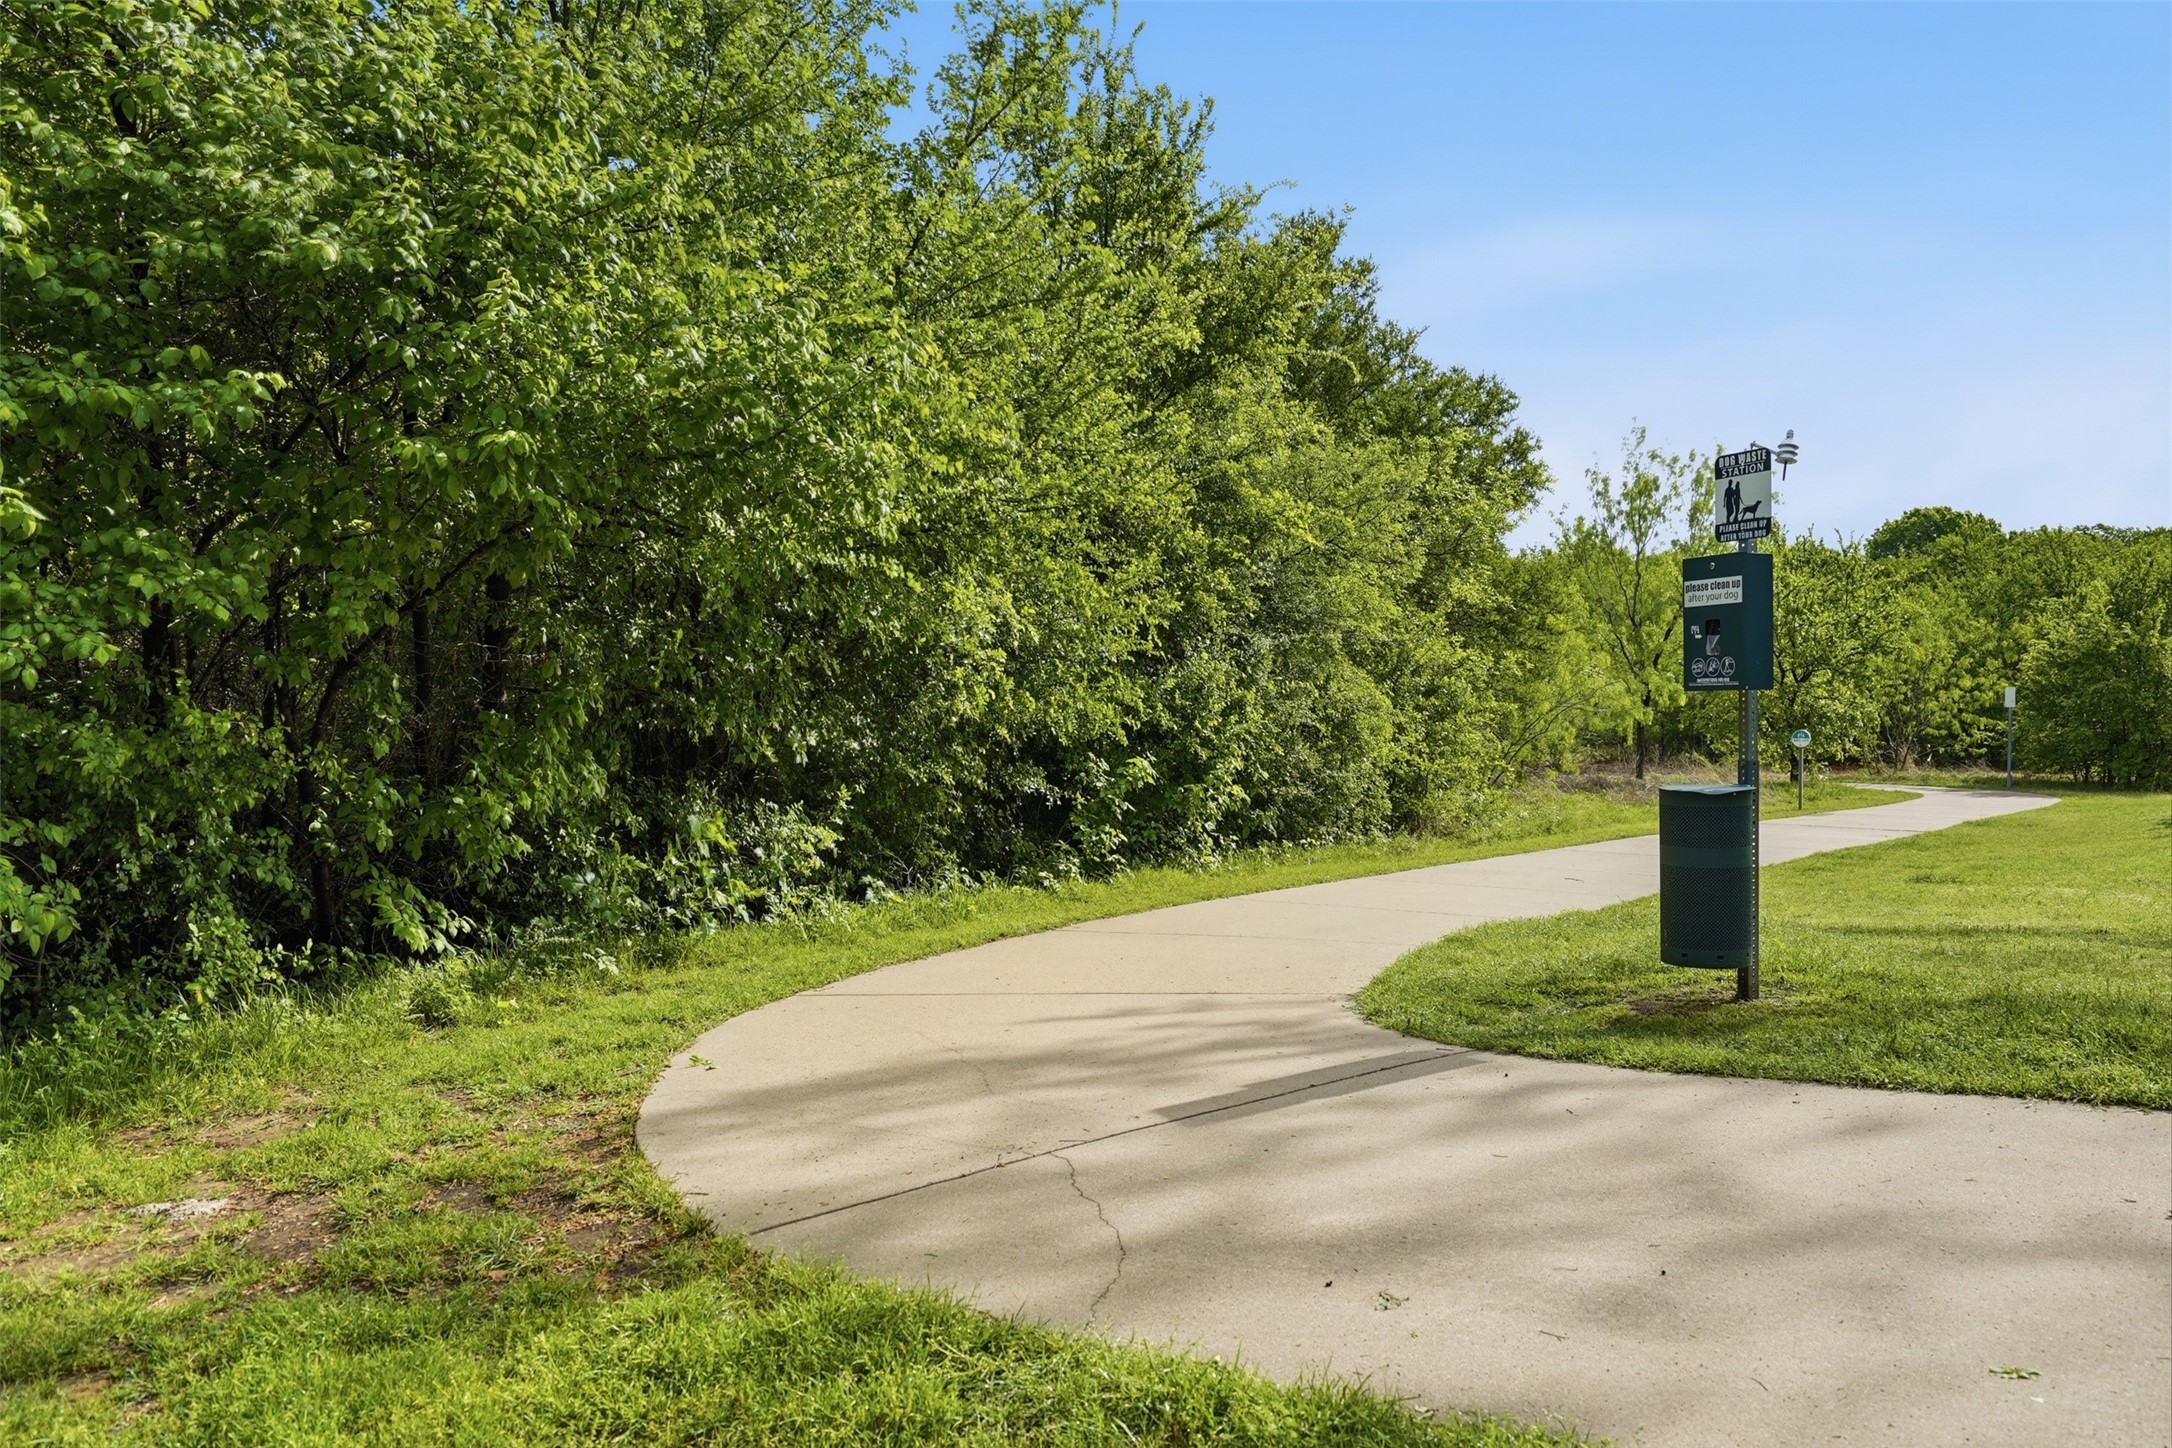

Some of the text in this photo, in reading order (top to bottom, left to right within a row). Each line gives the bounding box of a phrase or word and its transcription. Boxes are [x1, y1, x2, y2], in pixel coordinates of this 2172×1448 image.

[1718, 449, 1767, 468] DOG WASTE
[1721, 462, 1764, 478] STATION
[1719, 519, 1767, 533] PLEASE CLEAN UP
[1720, 529, 1767, 542] AFTER YOUR DOG
[1685, 579, 1740, 594] please clean up
[1687, 590, 1739, 603] after your dog
